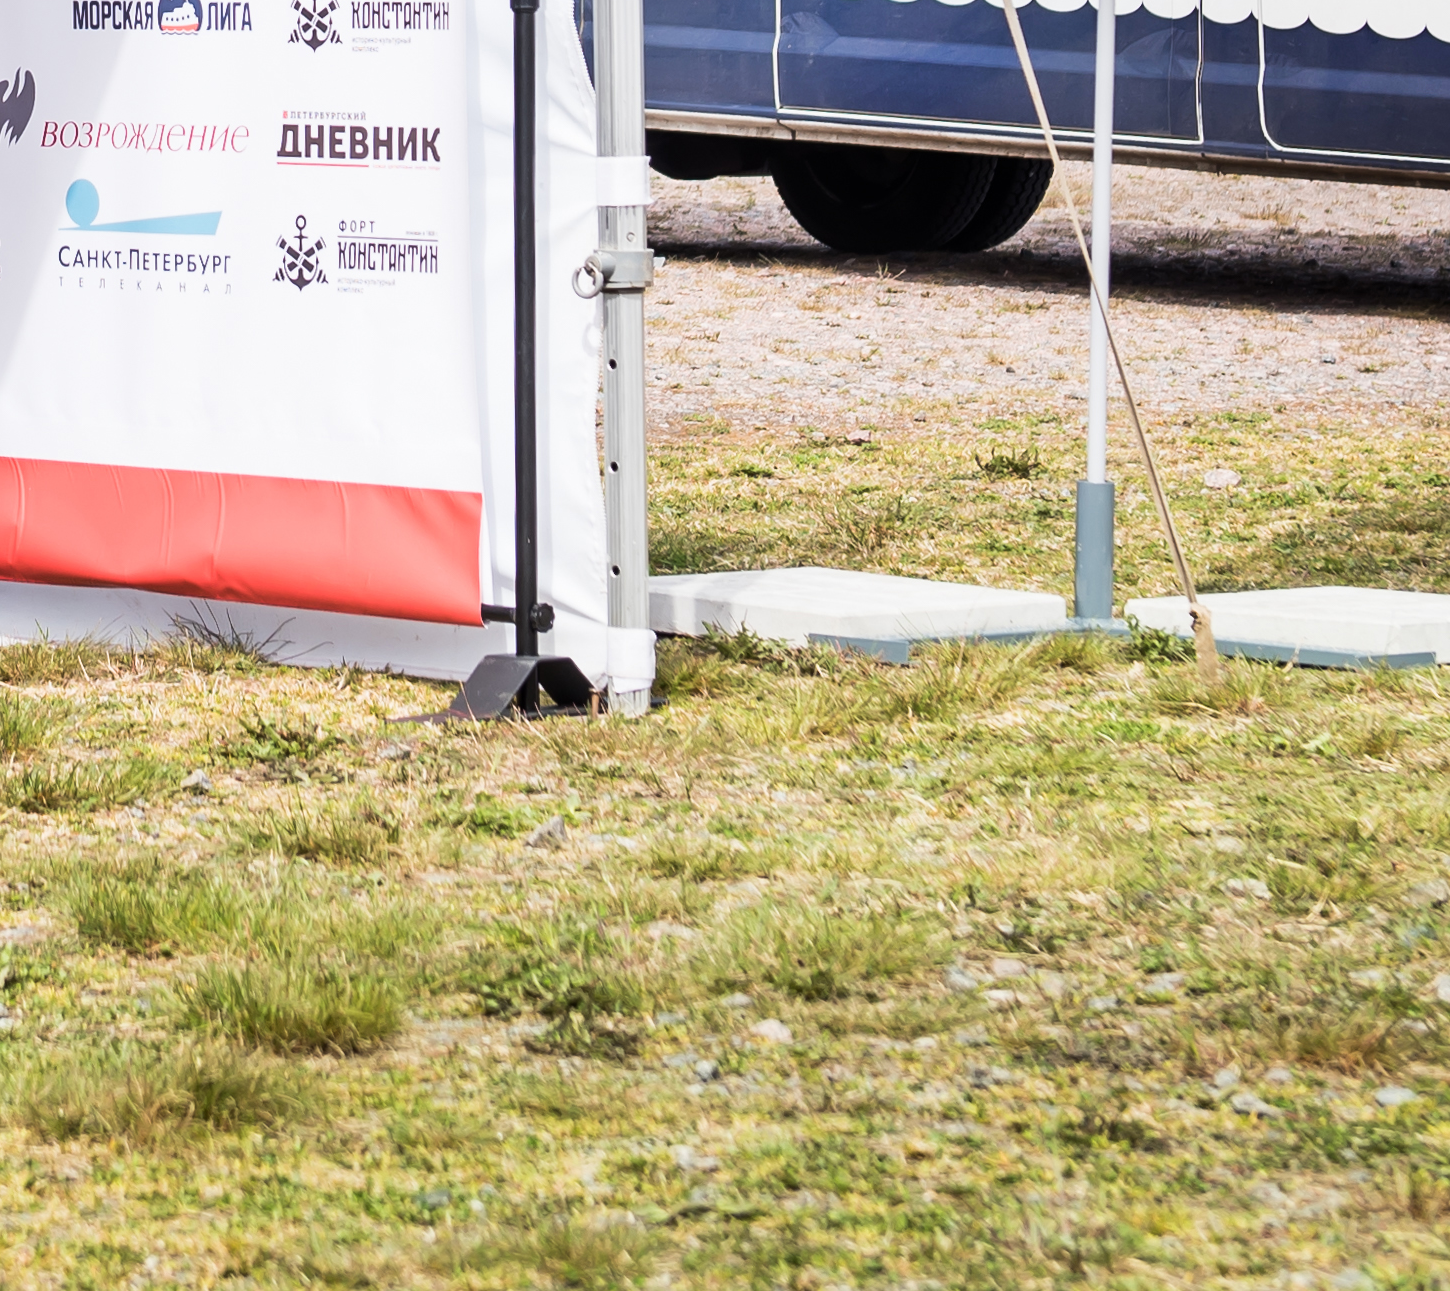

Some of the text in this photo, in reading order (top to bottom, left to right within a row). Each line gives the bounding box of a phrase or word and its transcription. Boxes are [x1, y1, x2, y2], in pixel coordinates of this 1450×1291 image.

[73, 0, 252, 31] МОРСКАЯ ЛИГА
[351, 1, 449, 30] КОНСТАНТИН
[276, 123, 442, 162] ДНЕВНИК
[339, 220, 375, 233] ФОРТ
[338, 242, 438, 273] КОНСТАНТИН
